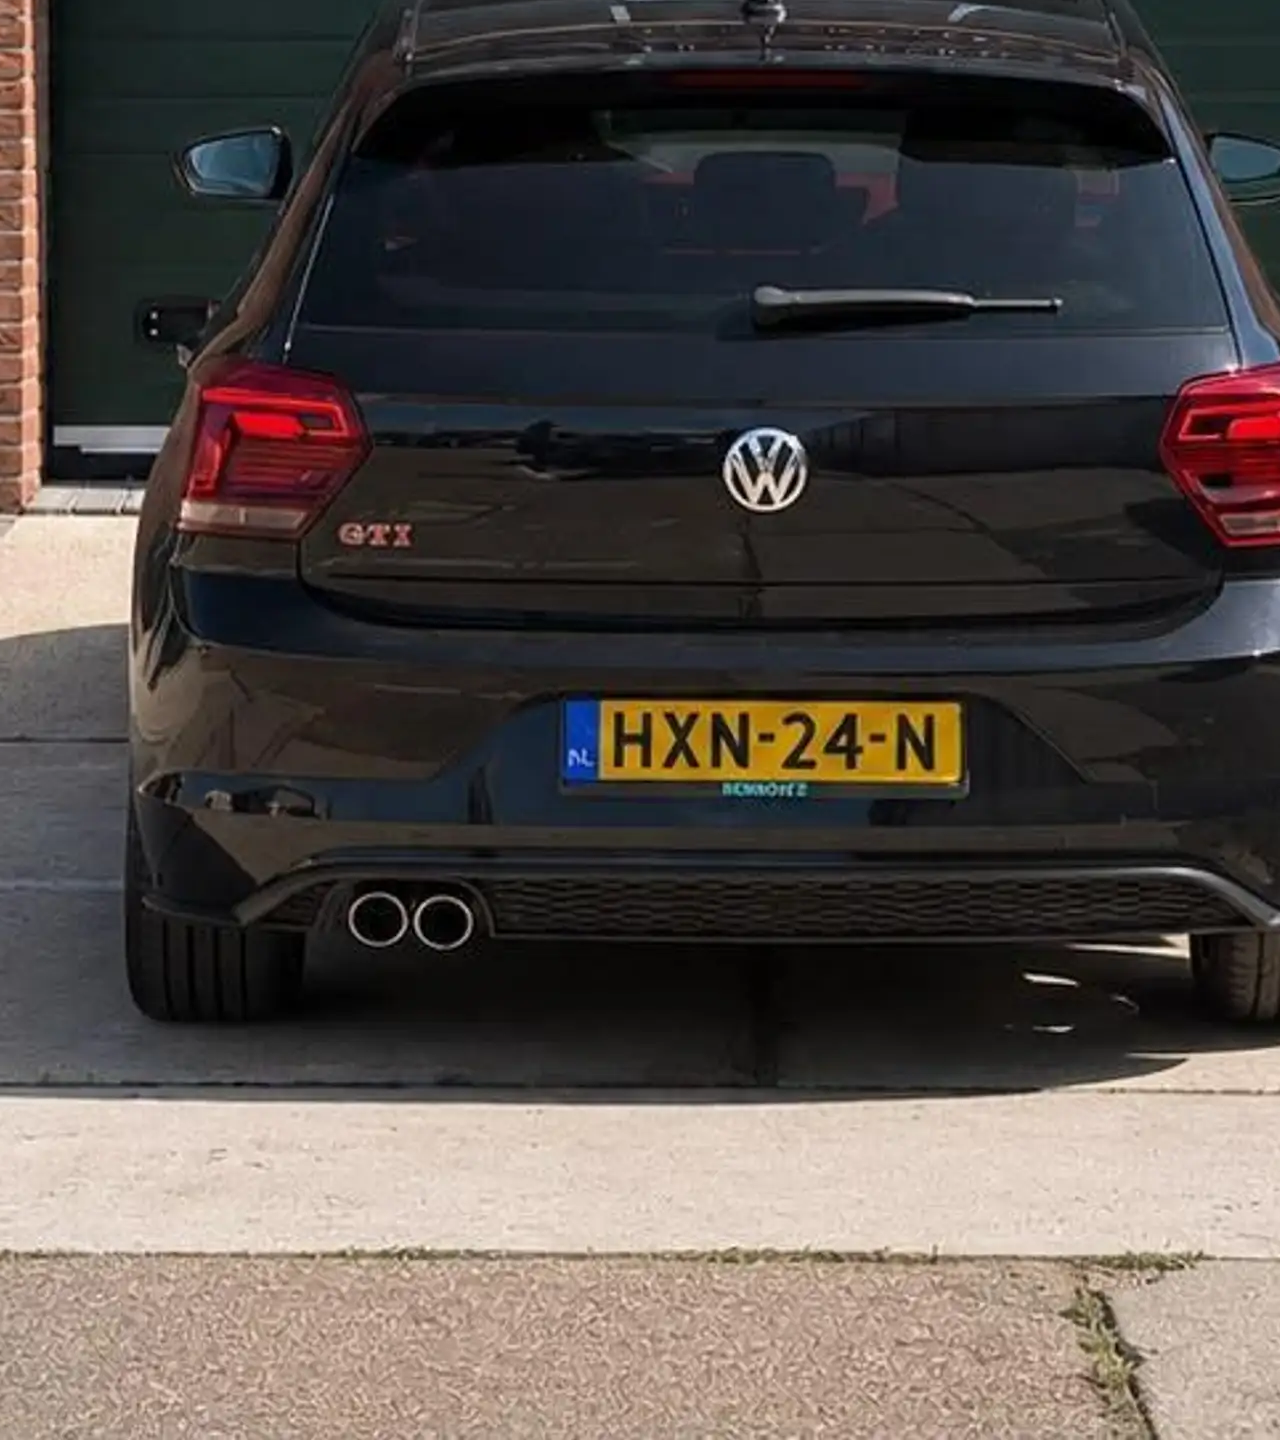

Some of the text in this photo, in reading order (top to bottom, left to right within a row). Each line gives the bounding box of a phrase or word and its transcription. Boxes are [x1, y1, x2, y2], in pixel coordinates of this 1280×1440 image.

[338, 521, 413, 547] GTI
[567, 710, 937, 772] NL HXN-24-N
